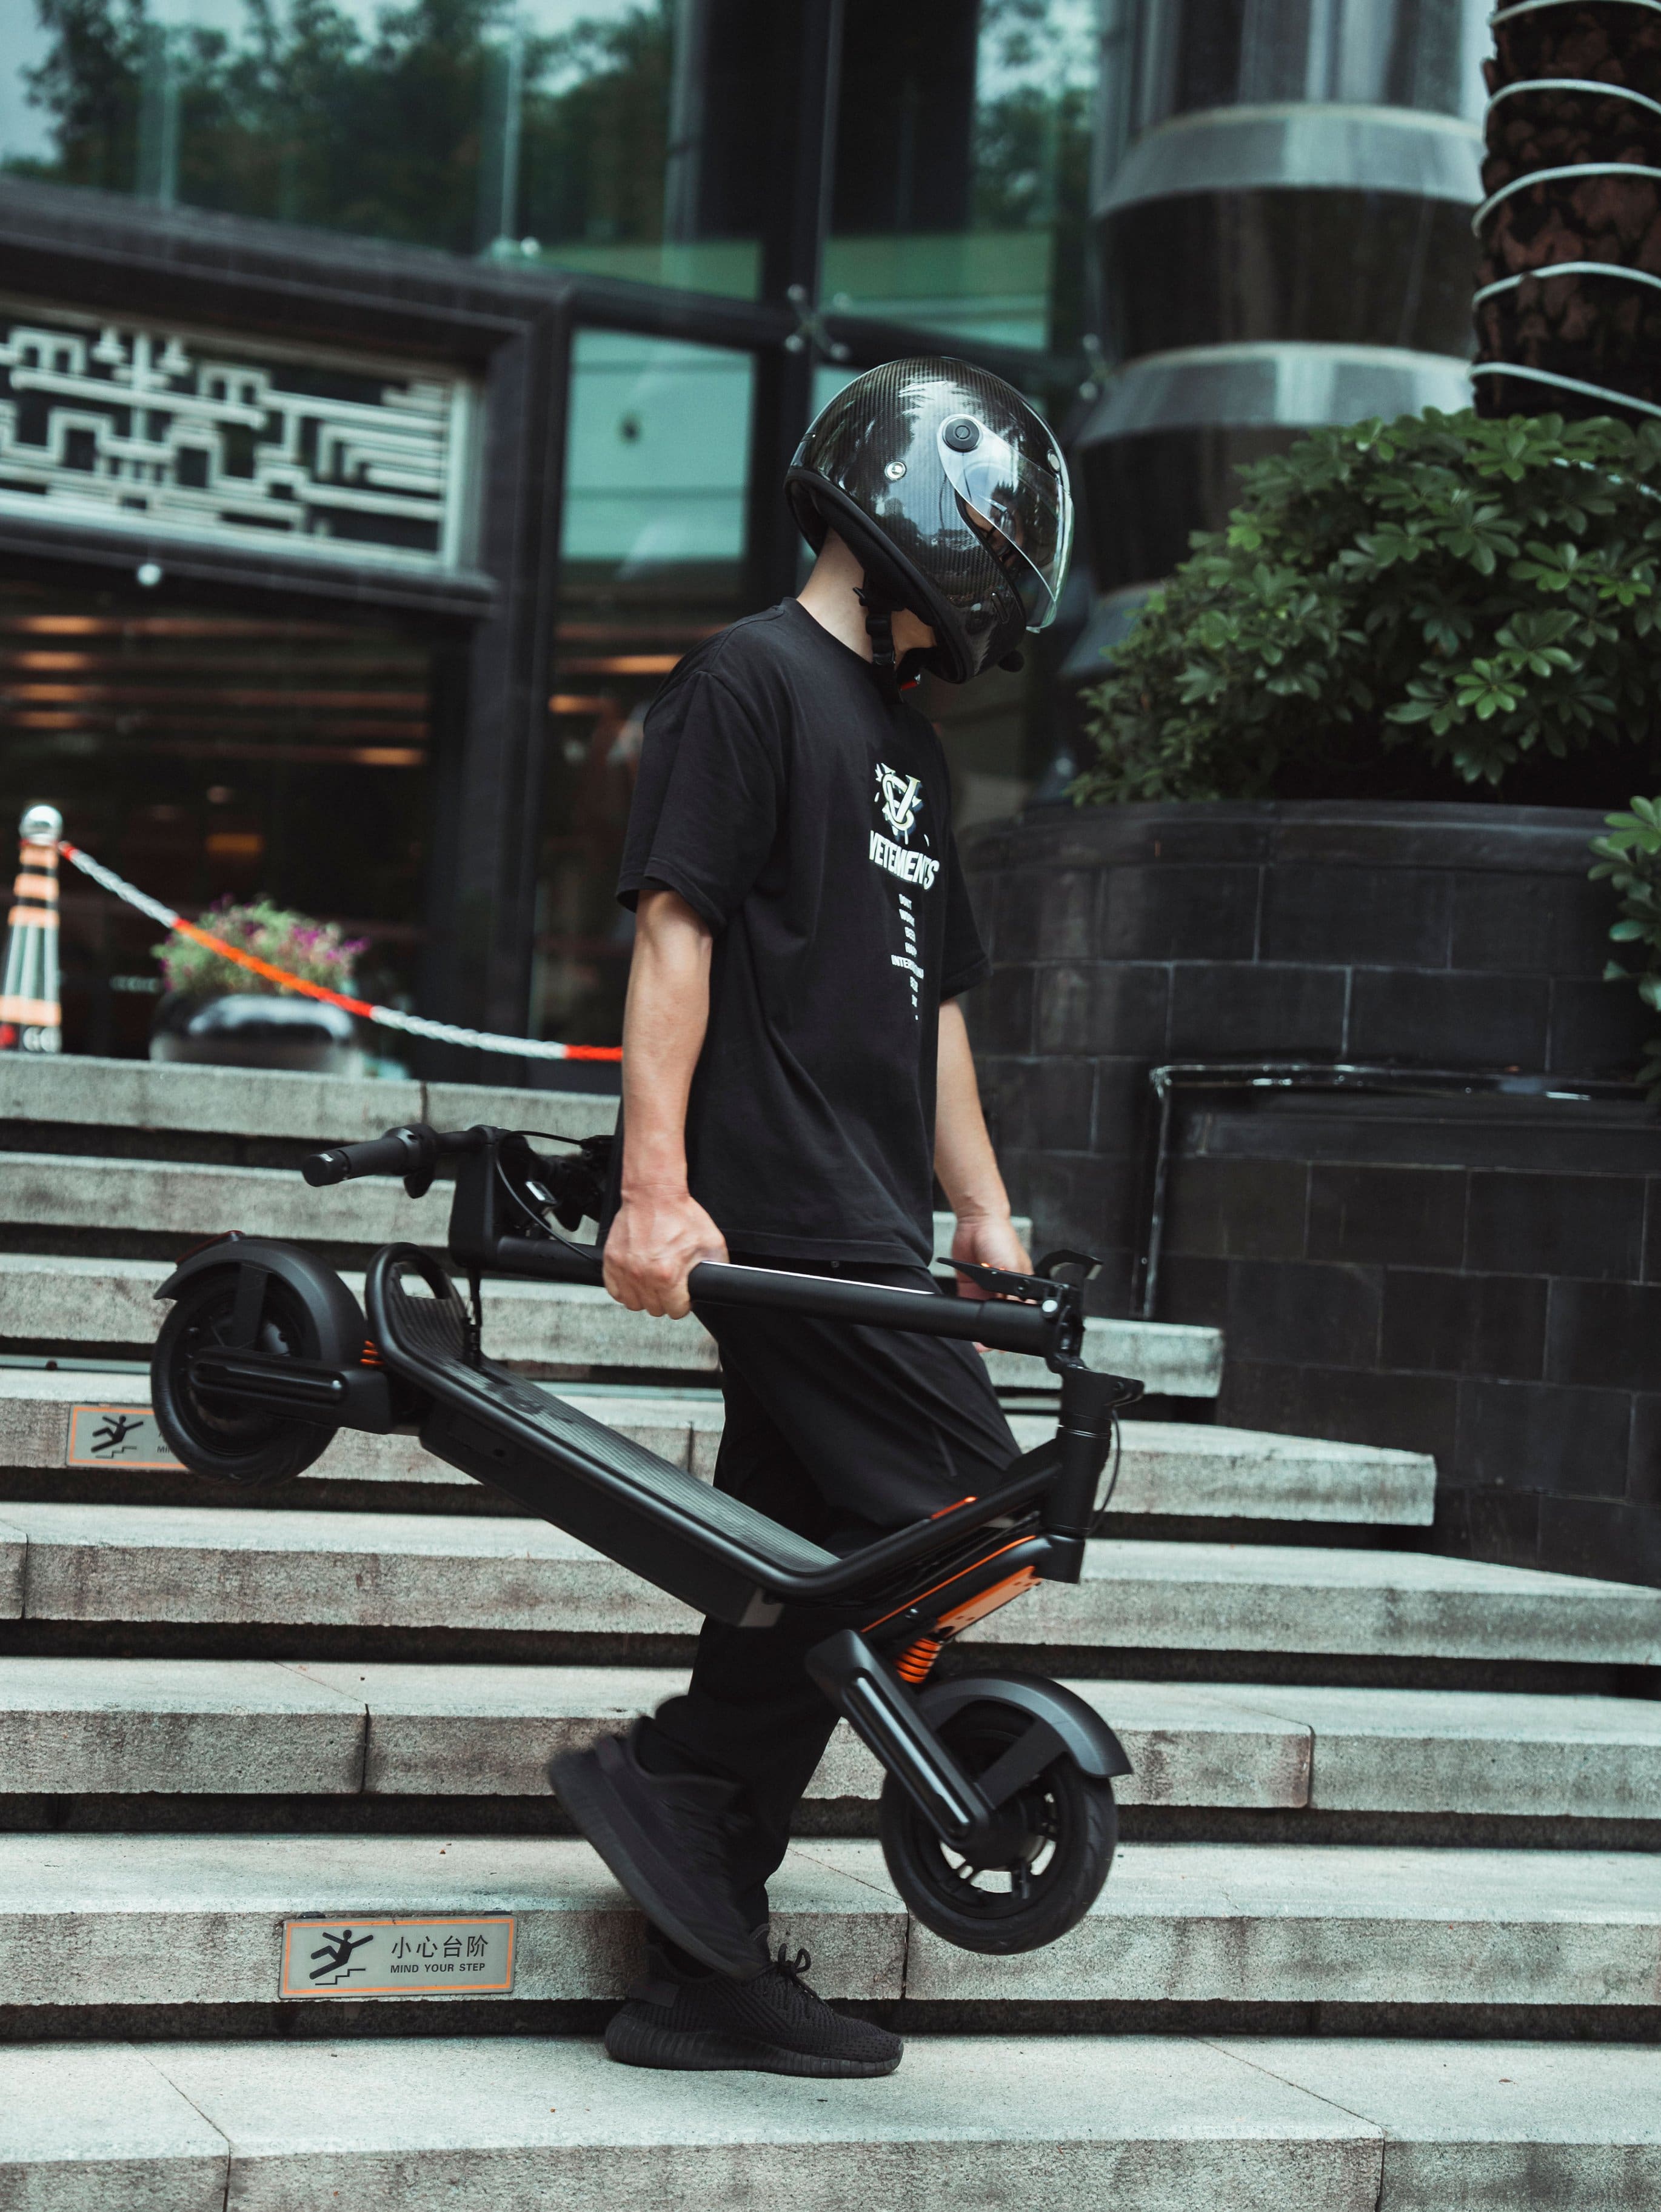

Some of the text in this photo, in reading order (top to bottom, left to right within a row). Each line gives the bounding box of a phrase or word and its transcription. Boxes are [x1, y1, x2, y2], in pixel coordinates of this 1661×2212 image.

[869, 830, 940, 890] VETEMENTS
[391, 1934, 489, 1959] 小心台阶
[390, 1963, 486, 1973] MIND YOUR STEP
